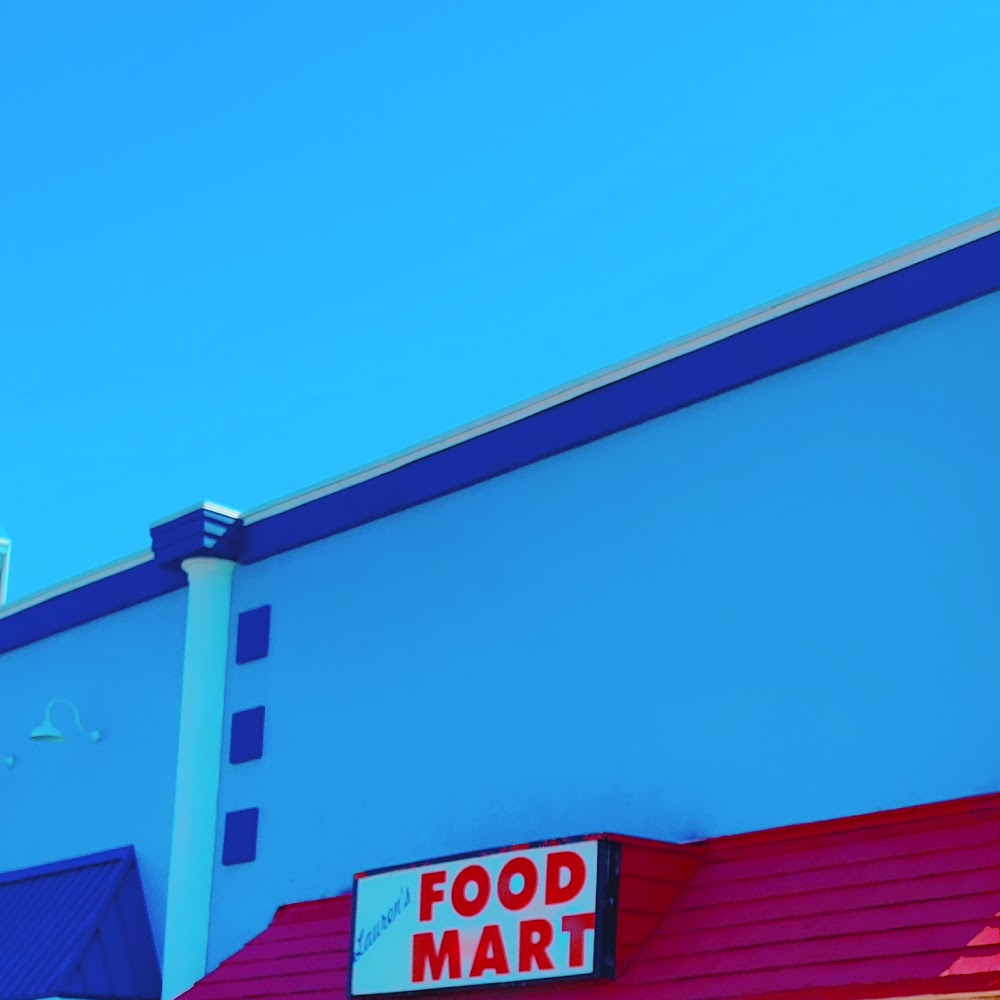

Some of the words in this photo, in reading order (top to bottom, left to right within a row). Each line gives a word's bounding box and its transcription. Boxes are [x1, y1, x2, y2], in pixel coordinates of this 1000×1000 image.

[419, 851, 586, 922] FOOD
[353, 884, 412, 963] Lauren's
[411, 913, 596, 983] MART
